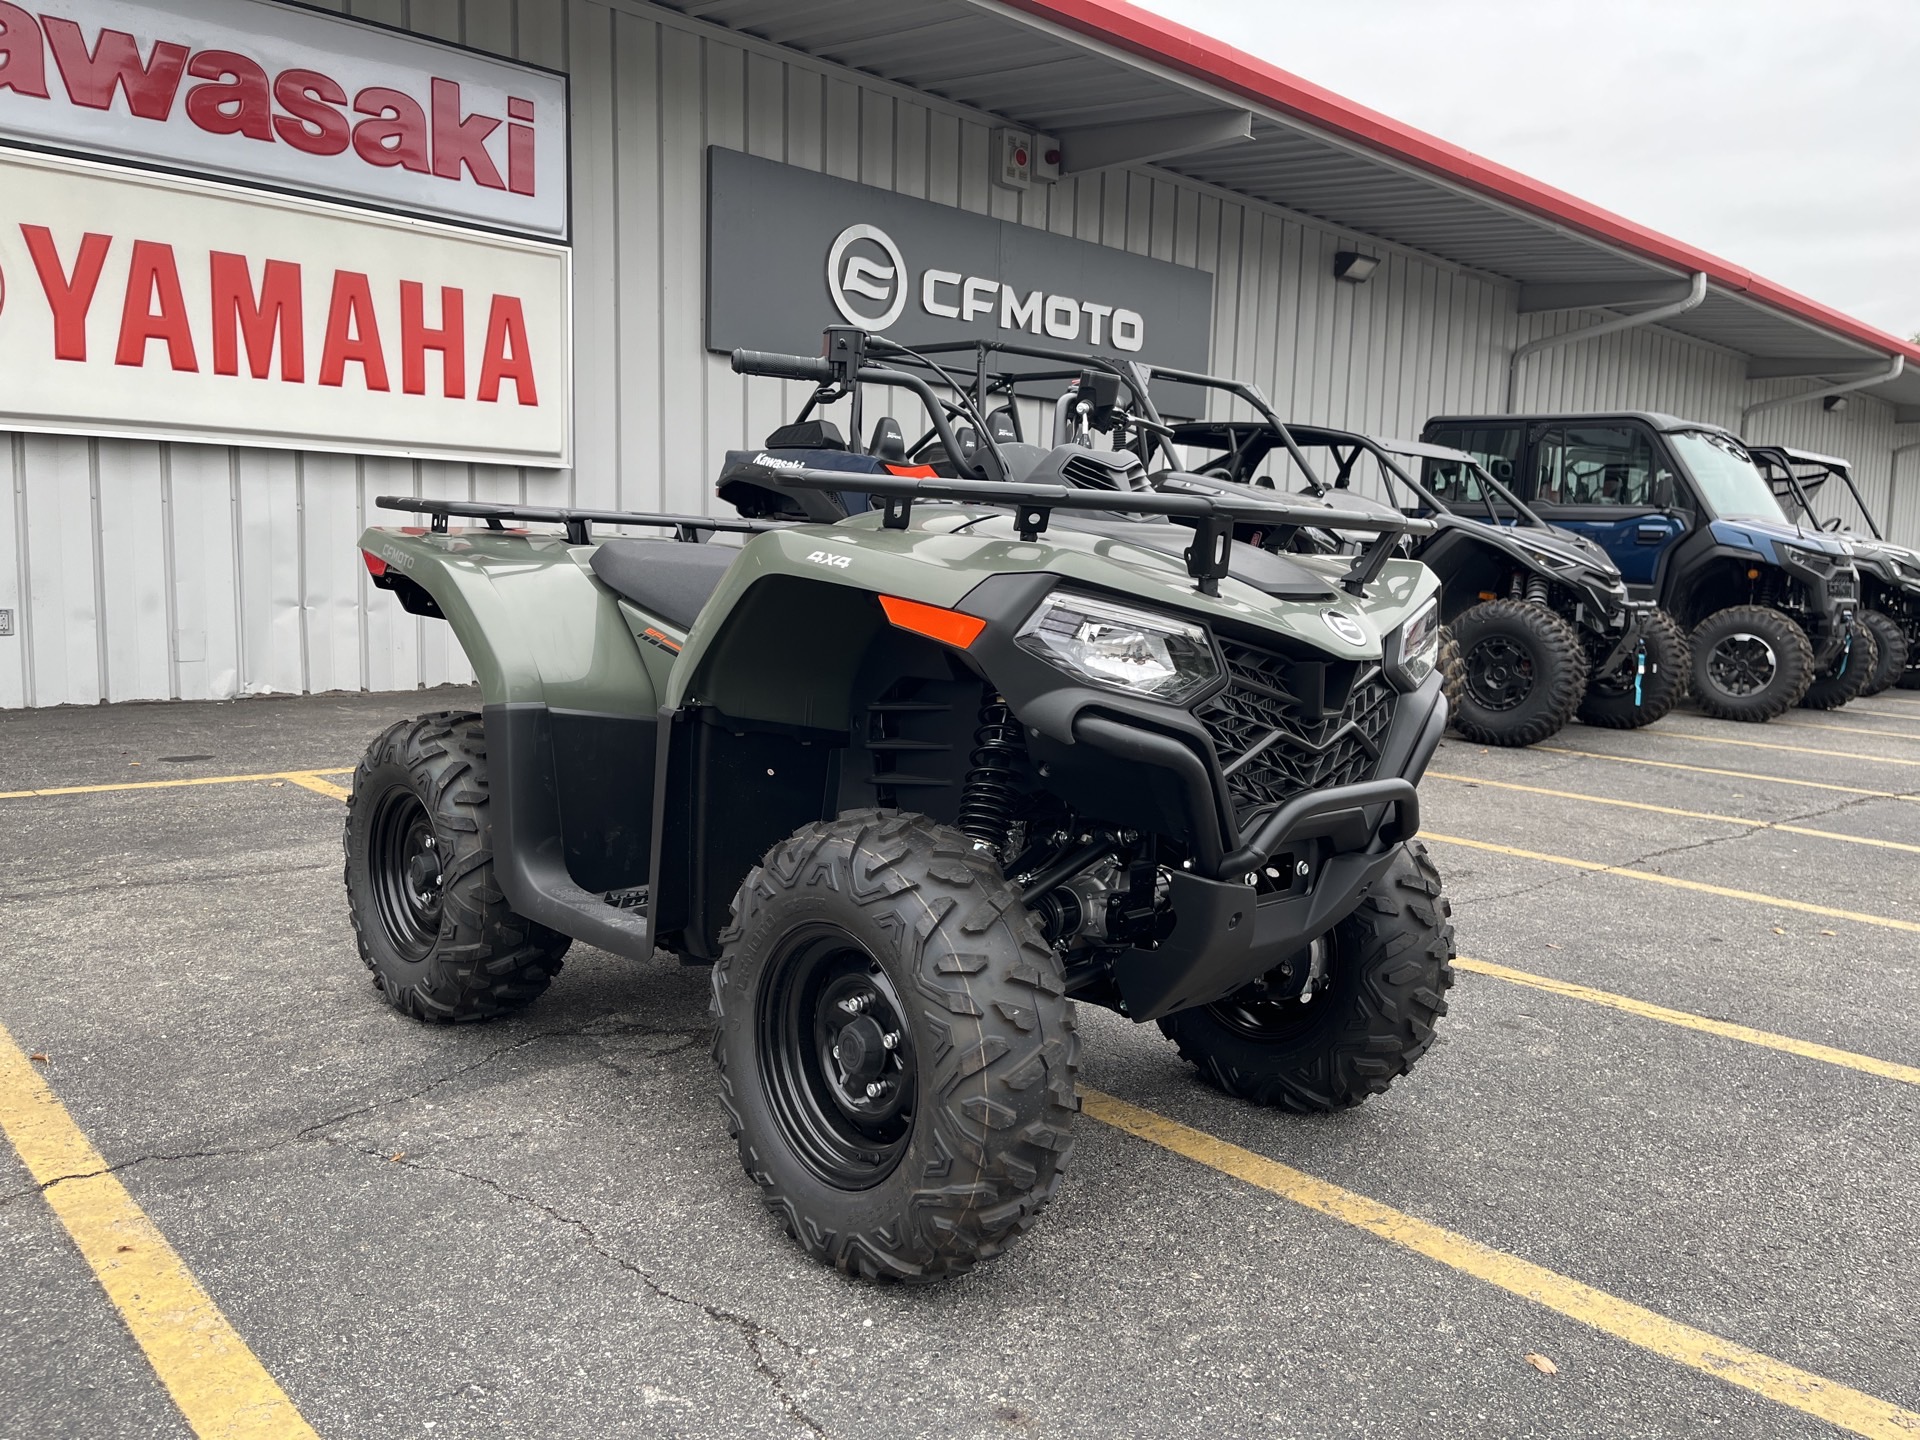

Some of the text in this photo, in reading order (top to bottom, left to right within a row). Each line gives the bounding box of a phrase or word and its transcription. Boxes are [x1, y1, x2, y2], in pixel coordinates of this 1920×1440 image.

[19, 222, 539, 407] YAMAHA
[922, 268, 1144, 353] CFMOTO
[382, 543, 415, 569] CFMOTO
